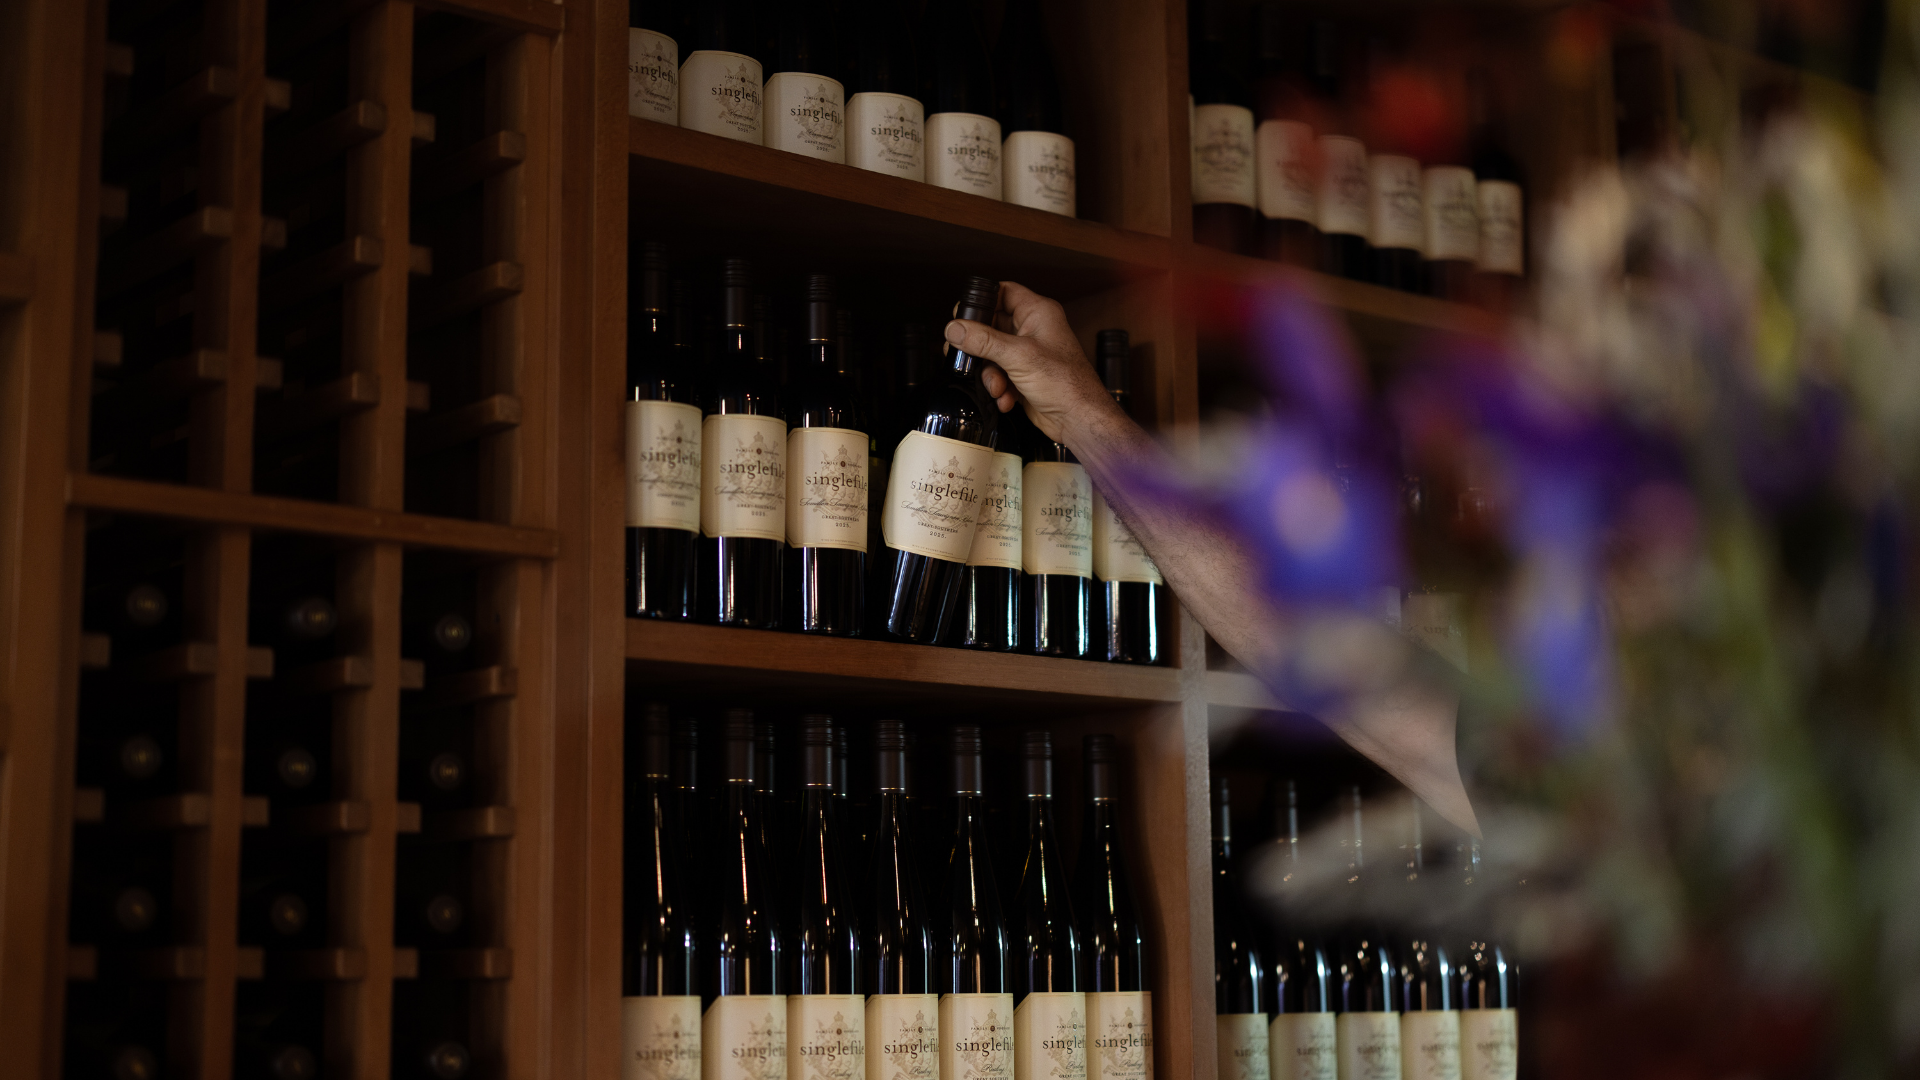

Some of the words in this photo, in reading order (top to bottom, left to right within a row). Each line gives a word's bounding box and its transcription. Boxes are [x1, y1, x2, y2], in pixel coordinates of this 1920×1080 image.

[640, 447, 700, 469] singlefi
[720, 459, 785, 479] singlefile
[805, 471, 867, 491] singlefile
[910, 478, 978, 503] singlefile
[1040, 503, 1092, 522] singlefi
[929, 530, 947, 539] 2025.
[1042, 1035, 1087, 1055] singlef
